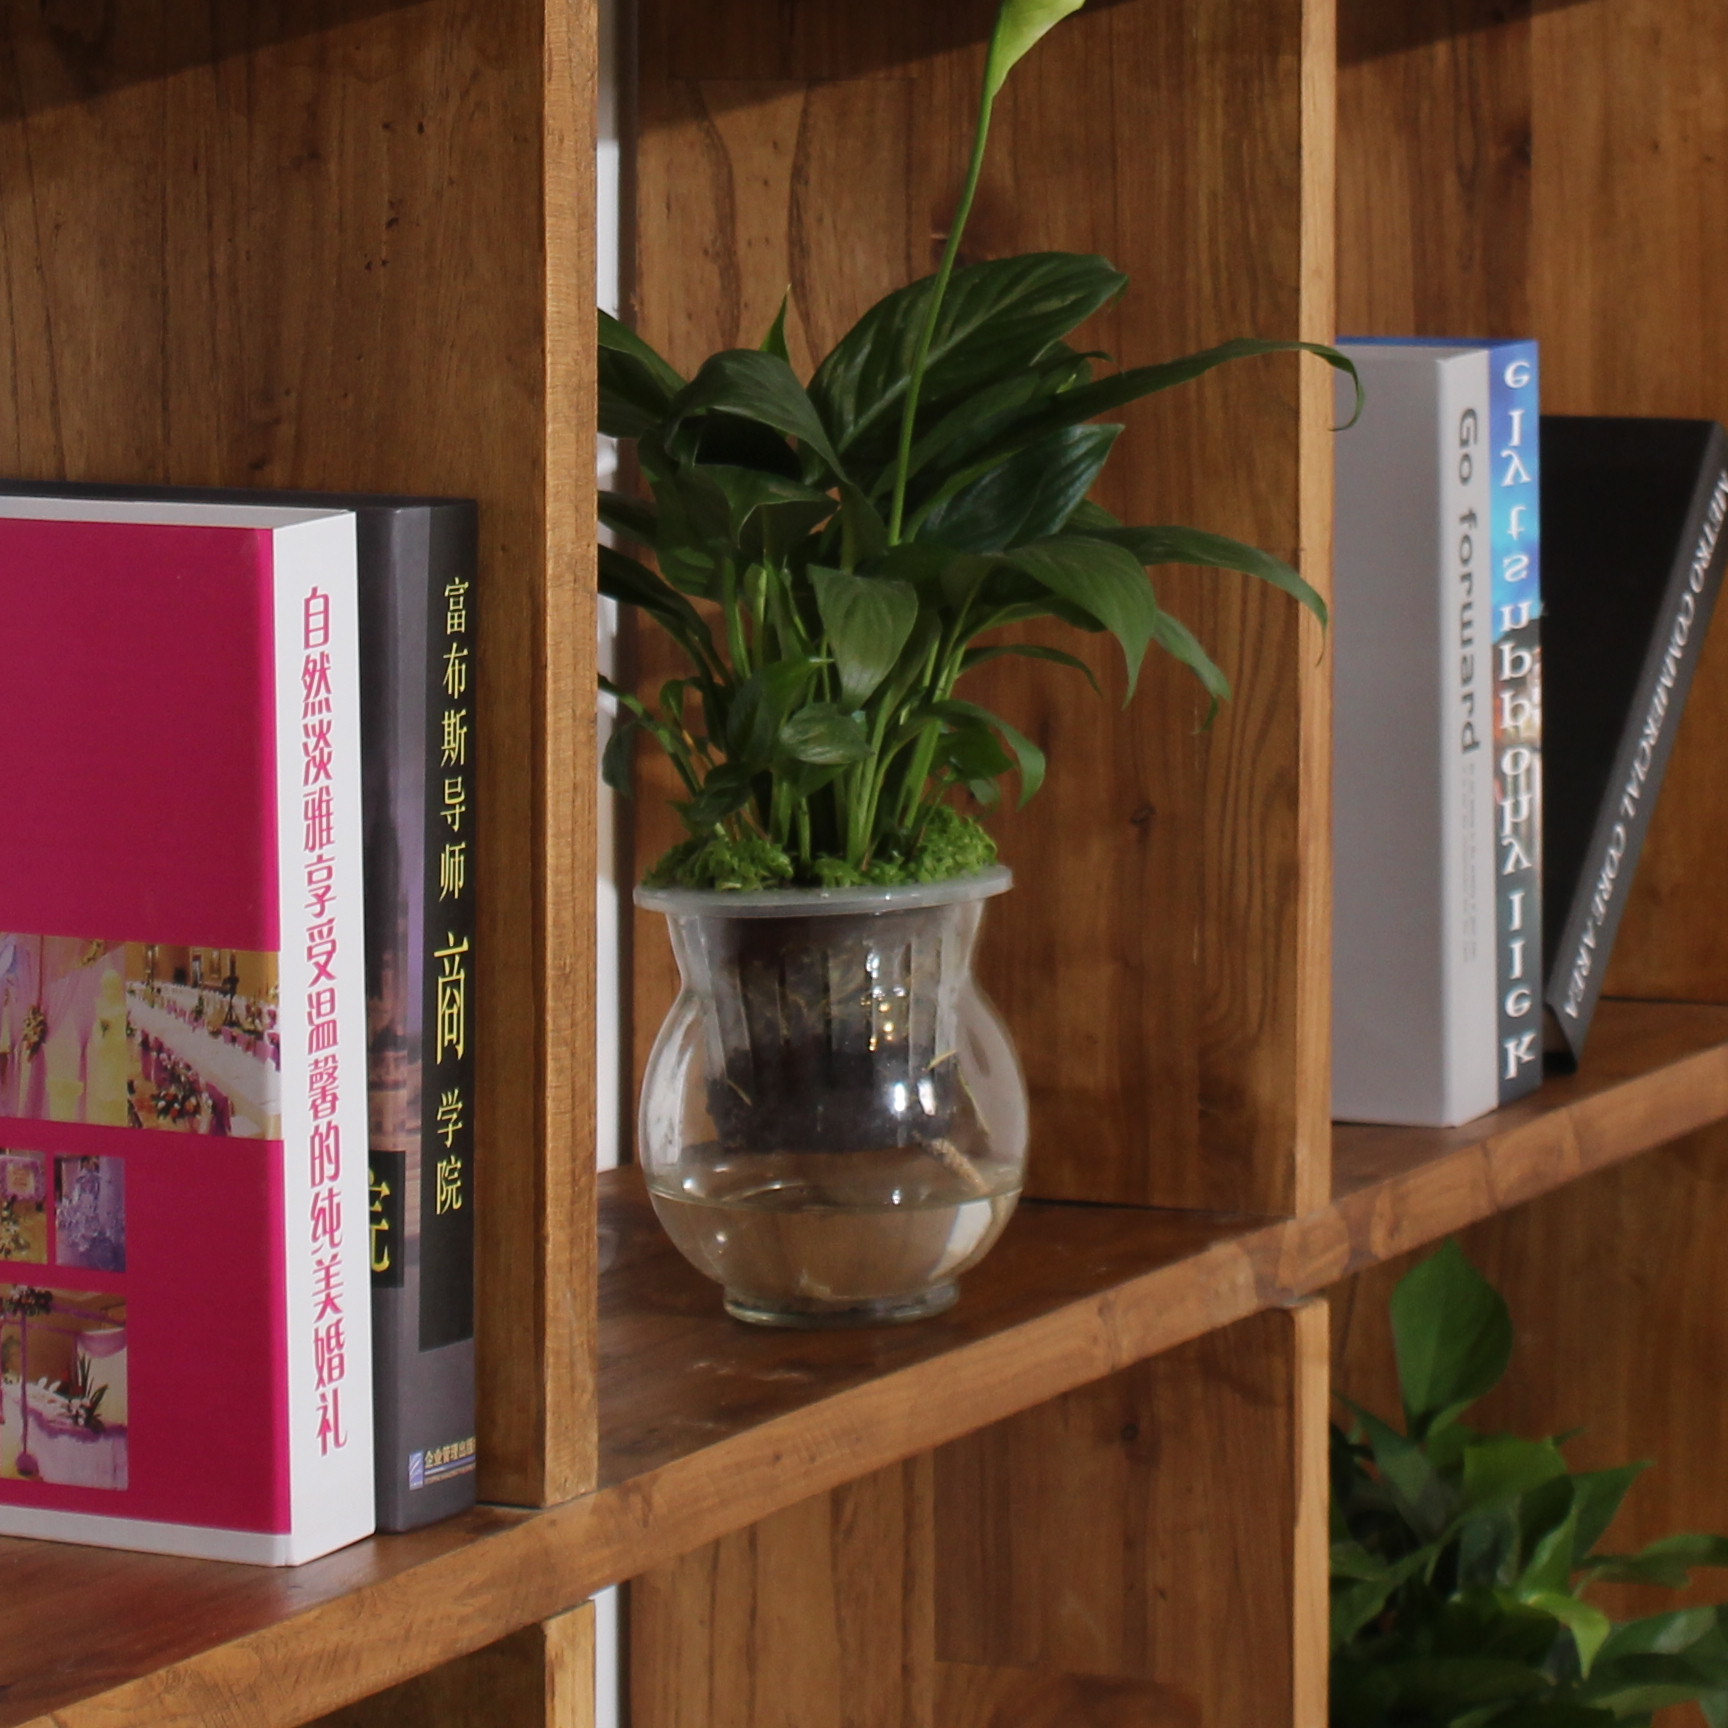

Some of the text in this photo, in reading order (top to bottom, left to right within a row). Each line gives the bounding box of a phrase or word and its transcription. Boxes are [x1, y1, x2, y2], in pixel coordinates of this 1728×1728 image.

[1458, 407, 1478, 487] Go
[1458, 506, 1481, 755] forward
[1621, 591, 1695, 819] COMMERCIAL
[1591, 822, 1626, 926] CORE
[300, 585, 349, 1457] 自然淡雅享受温馨的纯美婚礼
[1564, 918, 1596, 1018] AREA
